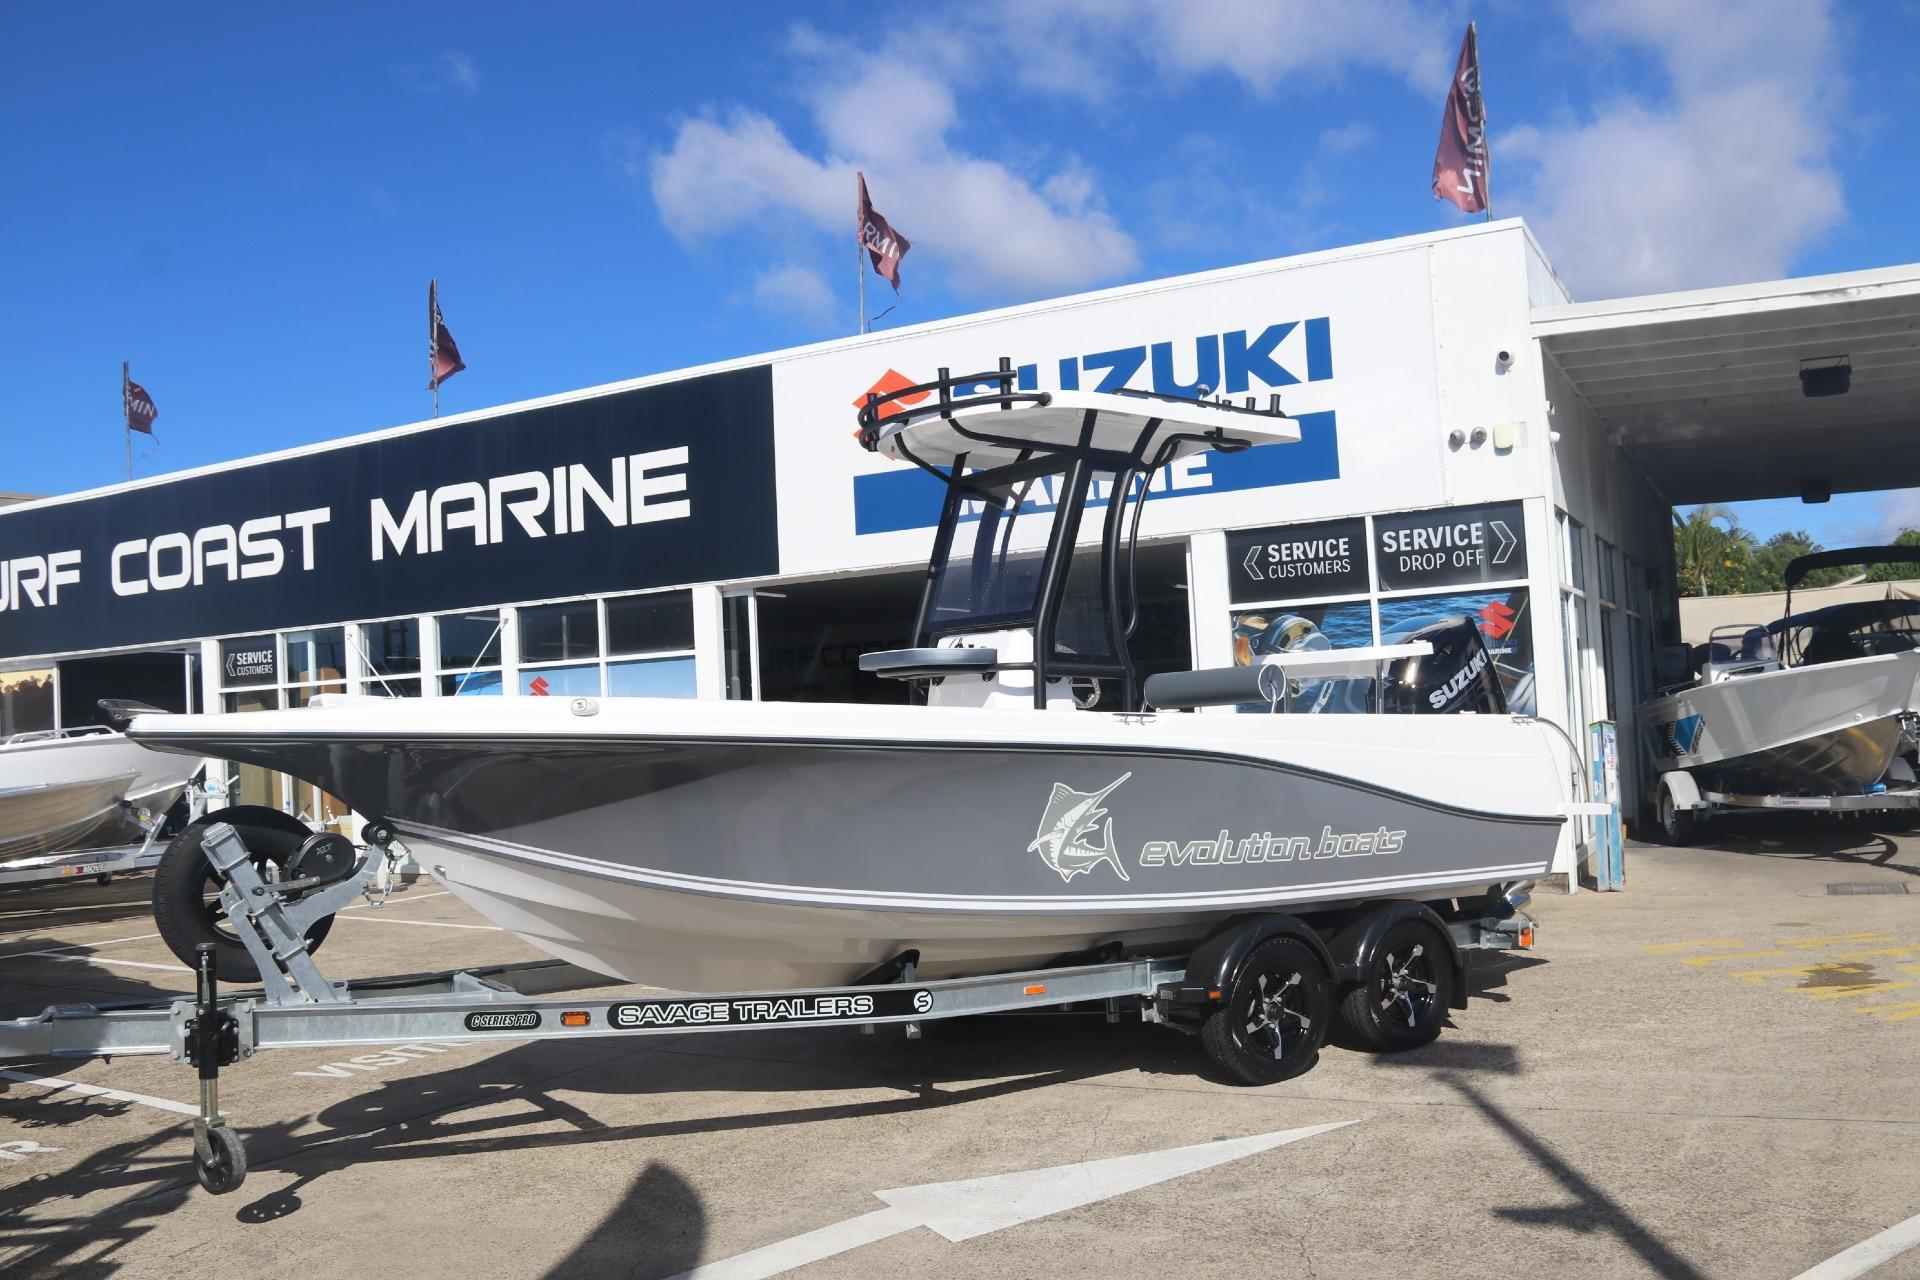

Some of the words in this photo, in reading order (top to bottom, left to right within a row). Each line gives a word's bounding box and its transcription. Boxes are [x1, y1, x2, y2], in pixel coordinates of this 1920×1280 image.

[953, 316, 1334, 402] ZUKI
[0, 550, 82, 613] RF
[111, 506, 331, 596] COAST
[370, 446, 691, 561] MARINE
[1382, 522, 1484, 553] SERVICE
[1267, 537, 1350, 563] SERVICE
[1399, 552, 1446, 573] DROP
[1452, 549, 1485, 567] OFF
[1268, 558, 1351, 580] CUSTOMERS
[236, 650, 273, 666] SERVICE
[236, 664, 274, 676] CUSTOMERS
[1429, 647, 1488, 709] SUZUKI
[1139, 829, 1311, 867] evolution
[1313, 825, 1407, 861] boats
[480, 1014, 515, 1028] SERIES
[515, 1013, 536, 1026] PRO
[618, 1003, 730, 1025] SAVAGE
[733, 996, 874, 1021] TRAILERS
